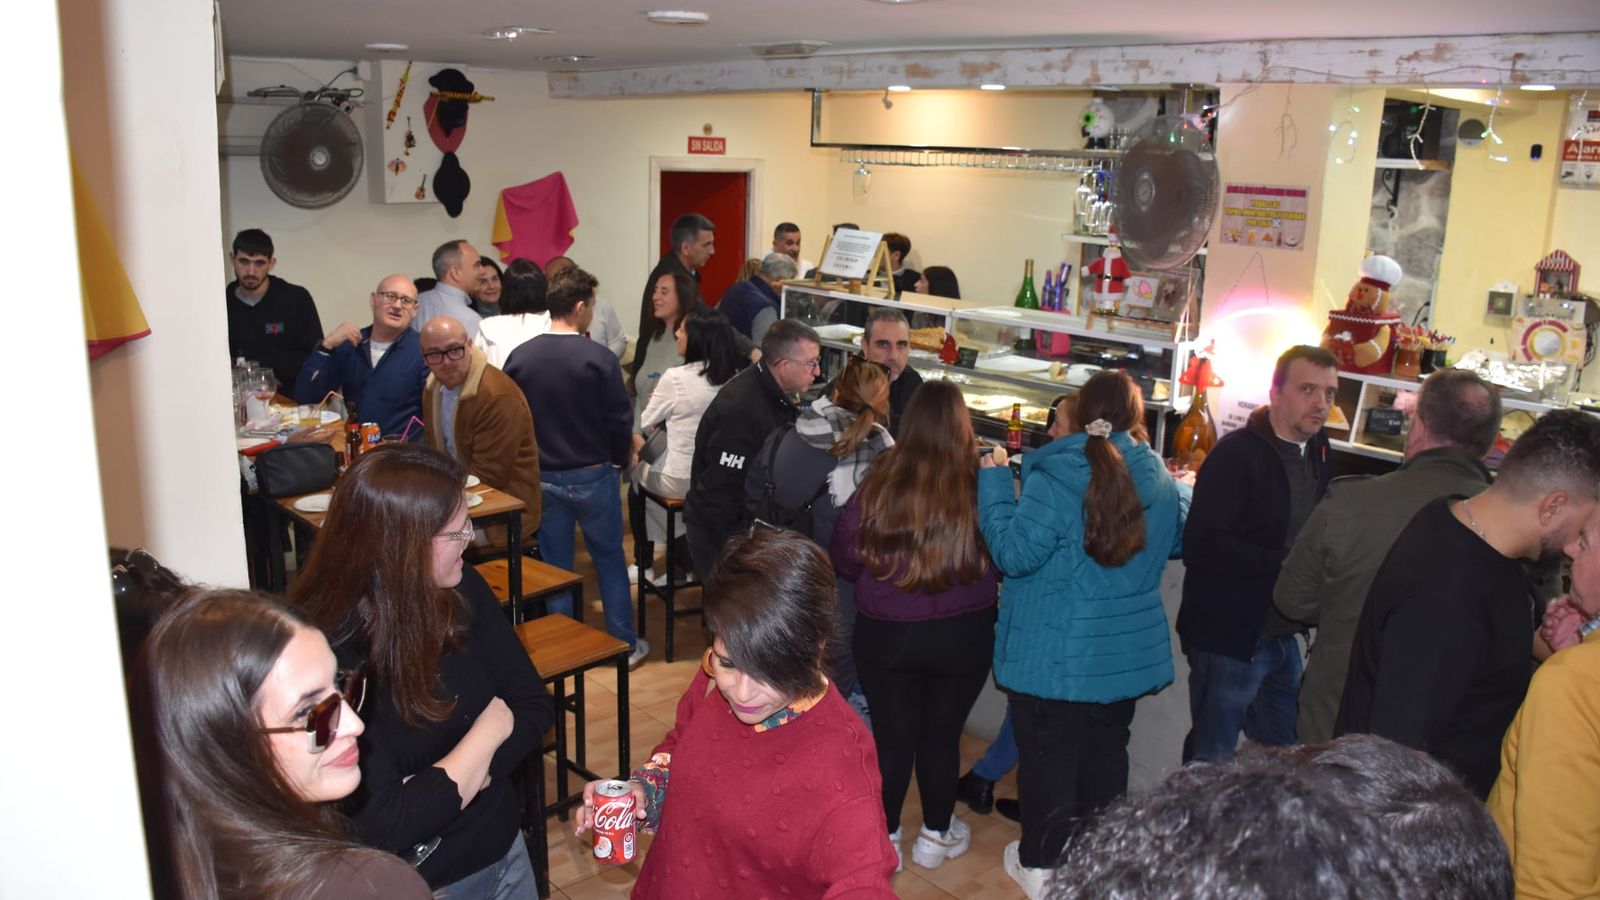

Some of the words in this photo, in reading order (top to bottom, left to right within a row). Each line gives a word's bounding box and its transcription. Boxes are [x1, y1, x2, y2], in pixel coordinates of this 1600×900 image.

[691, 140, 701, 151] SIN
[702, 140, 724, 152] SALIDA
[1567, 143, 1600, 154] Aar
[719, 451, 745, 469] HH
[594, 798, 634, 830] Cola
